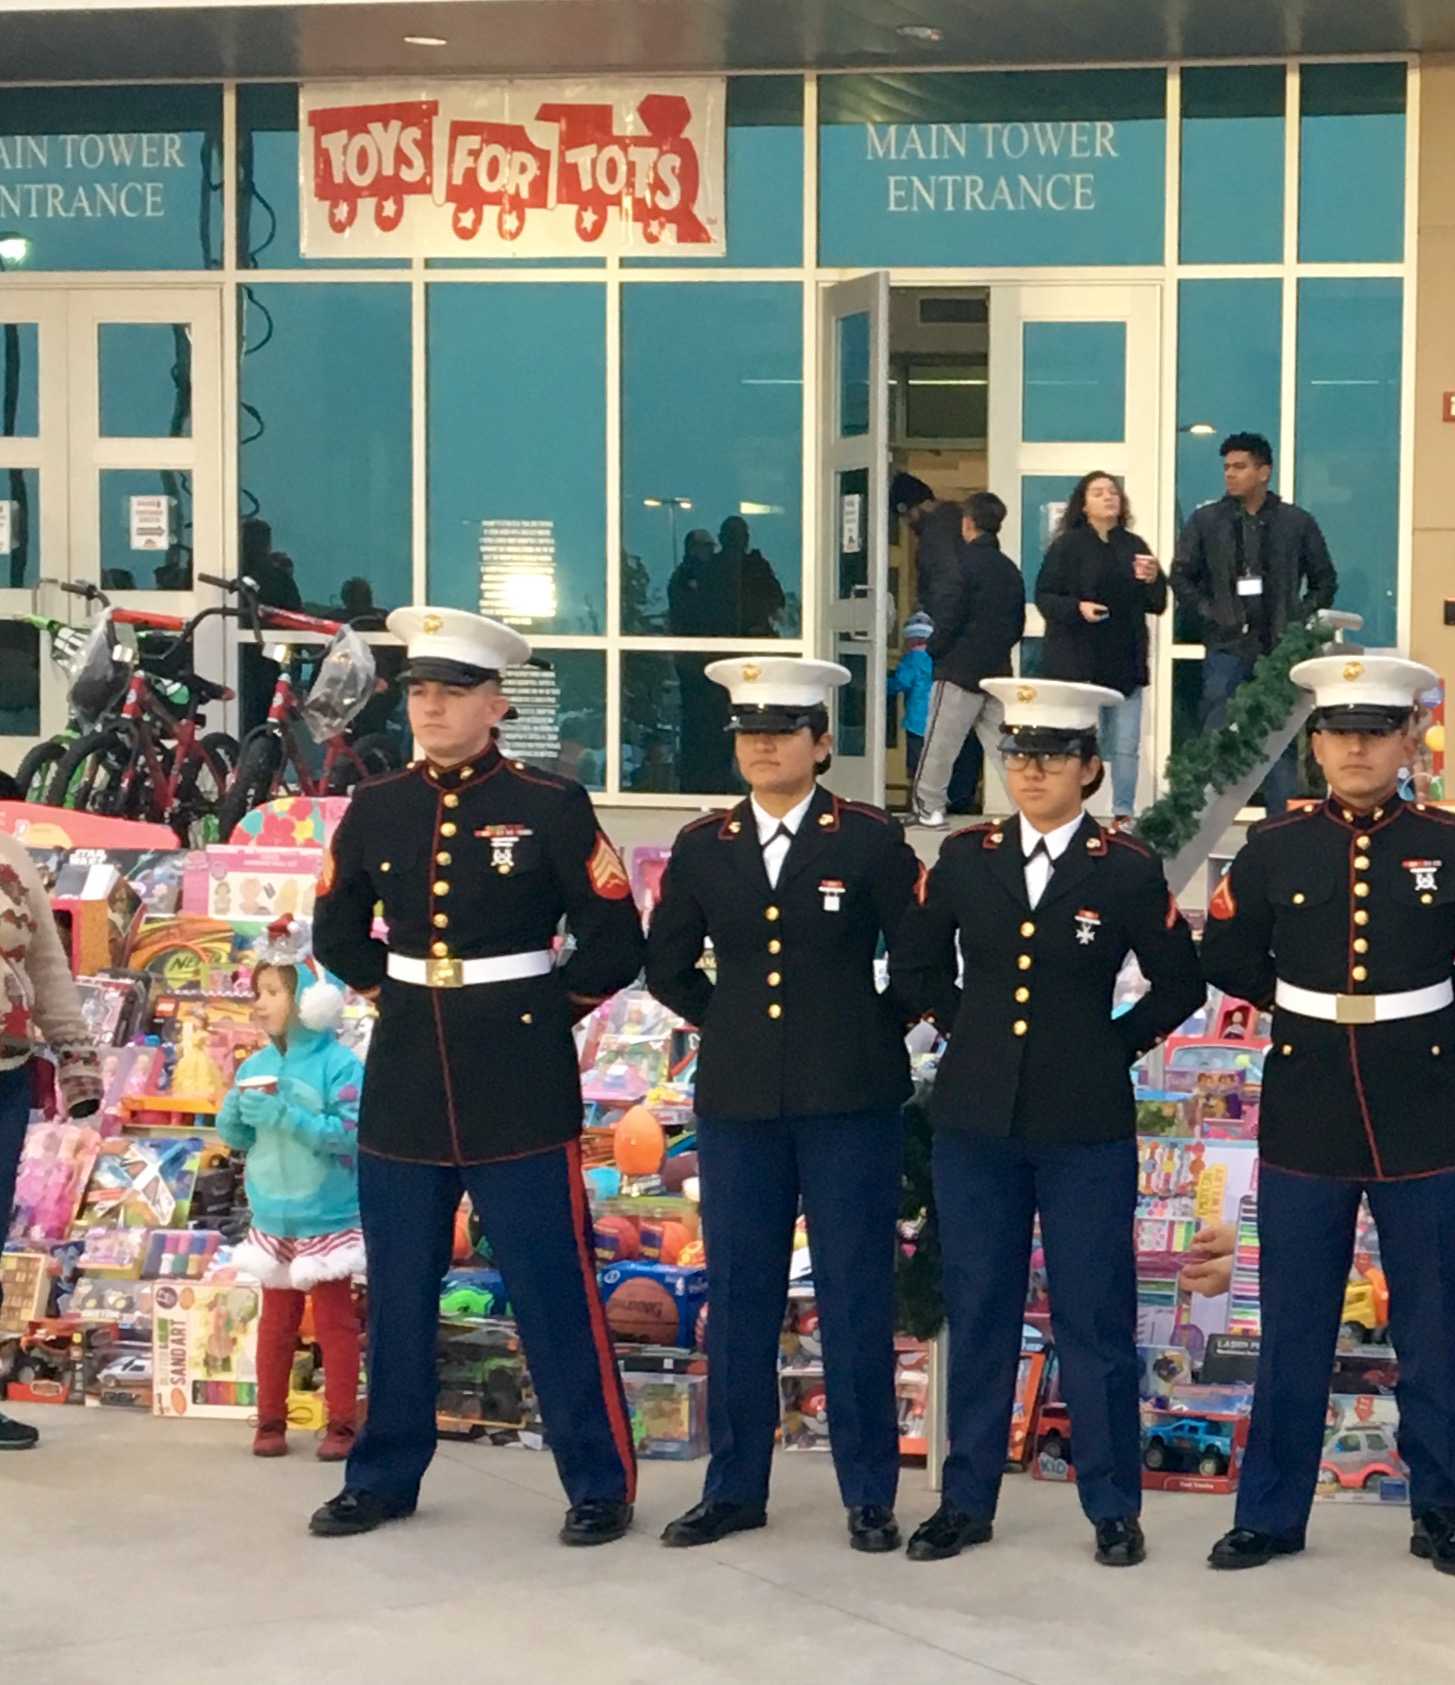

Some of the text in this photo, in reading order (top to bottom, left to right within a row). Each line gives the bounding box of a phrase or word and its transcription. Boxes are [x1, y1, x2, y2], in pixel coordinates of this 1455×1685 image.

[58, 133, 185, 169] TOWER
[866, 121, 1119, 160] MAIN TOWER
[321, 120, 682, 210] TOYS FOR TOTS
[887, 173, 1096, 212] ENTRANCE
[170, 1319, 187, 1386] SAND ART
[1040, 1456, 1067, 1475] KID
